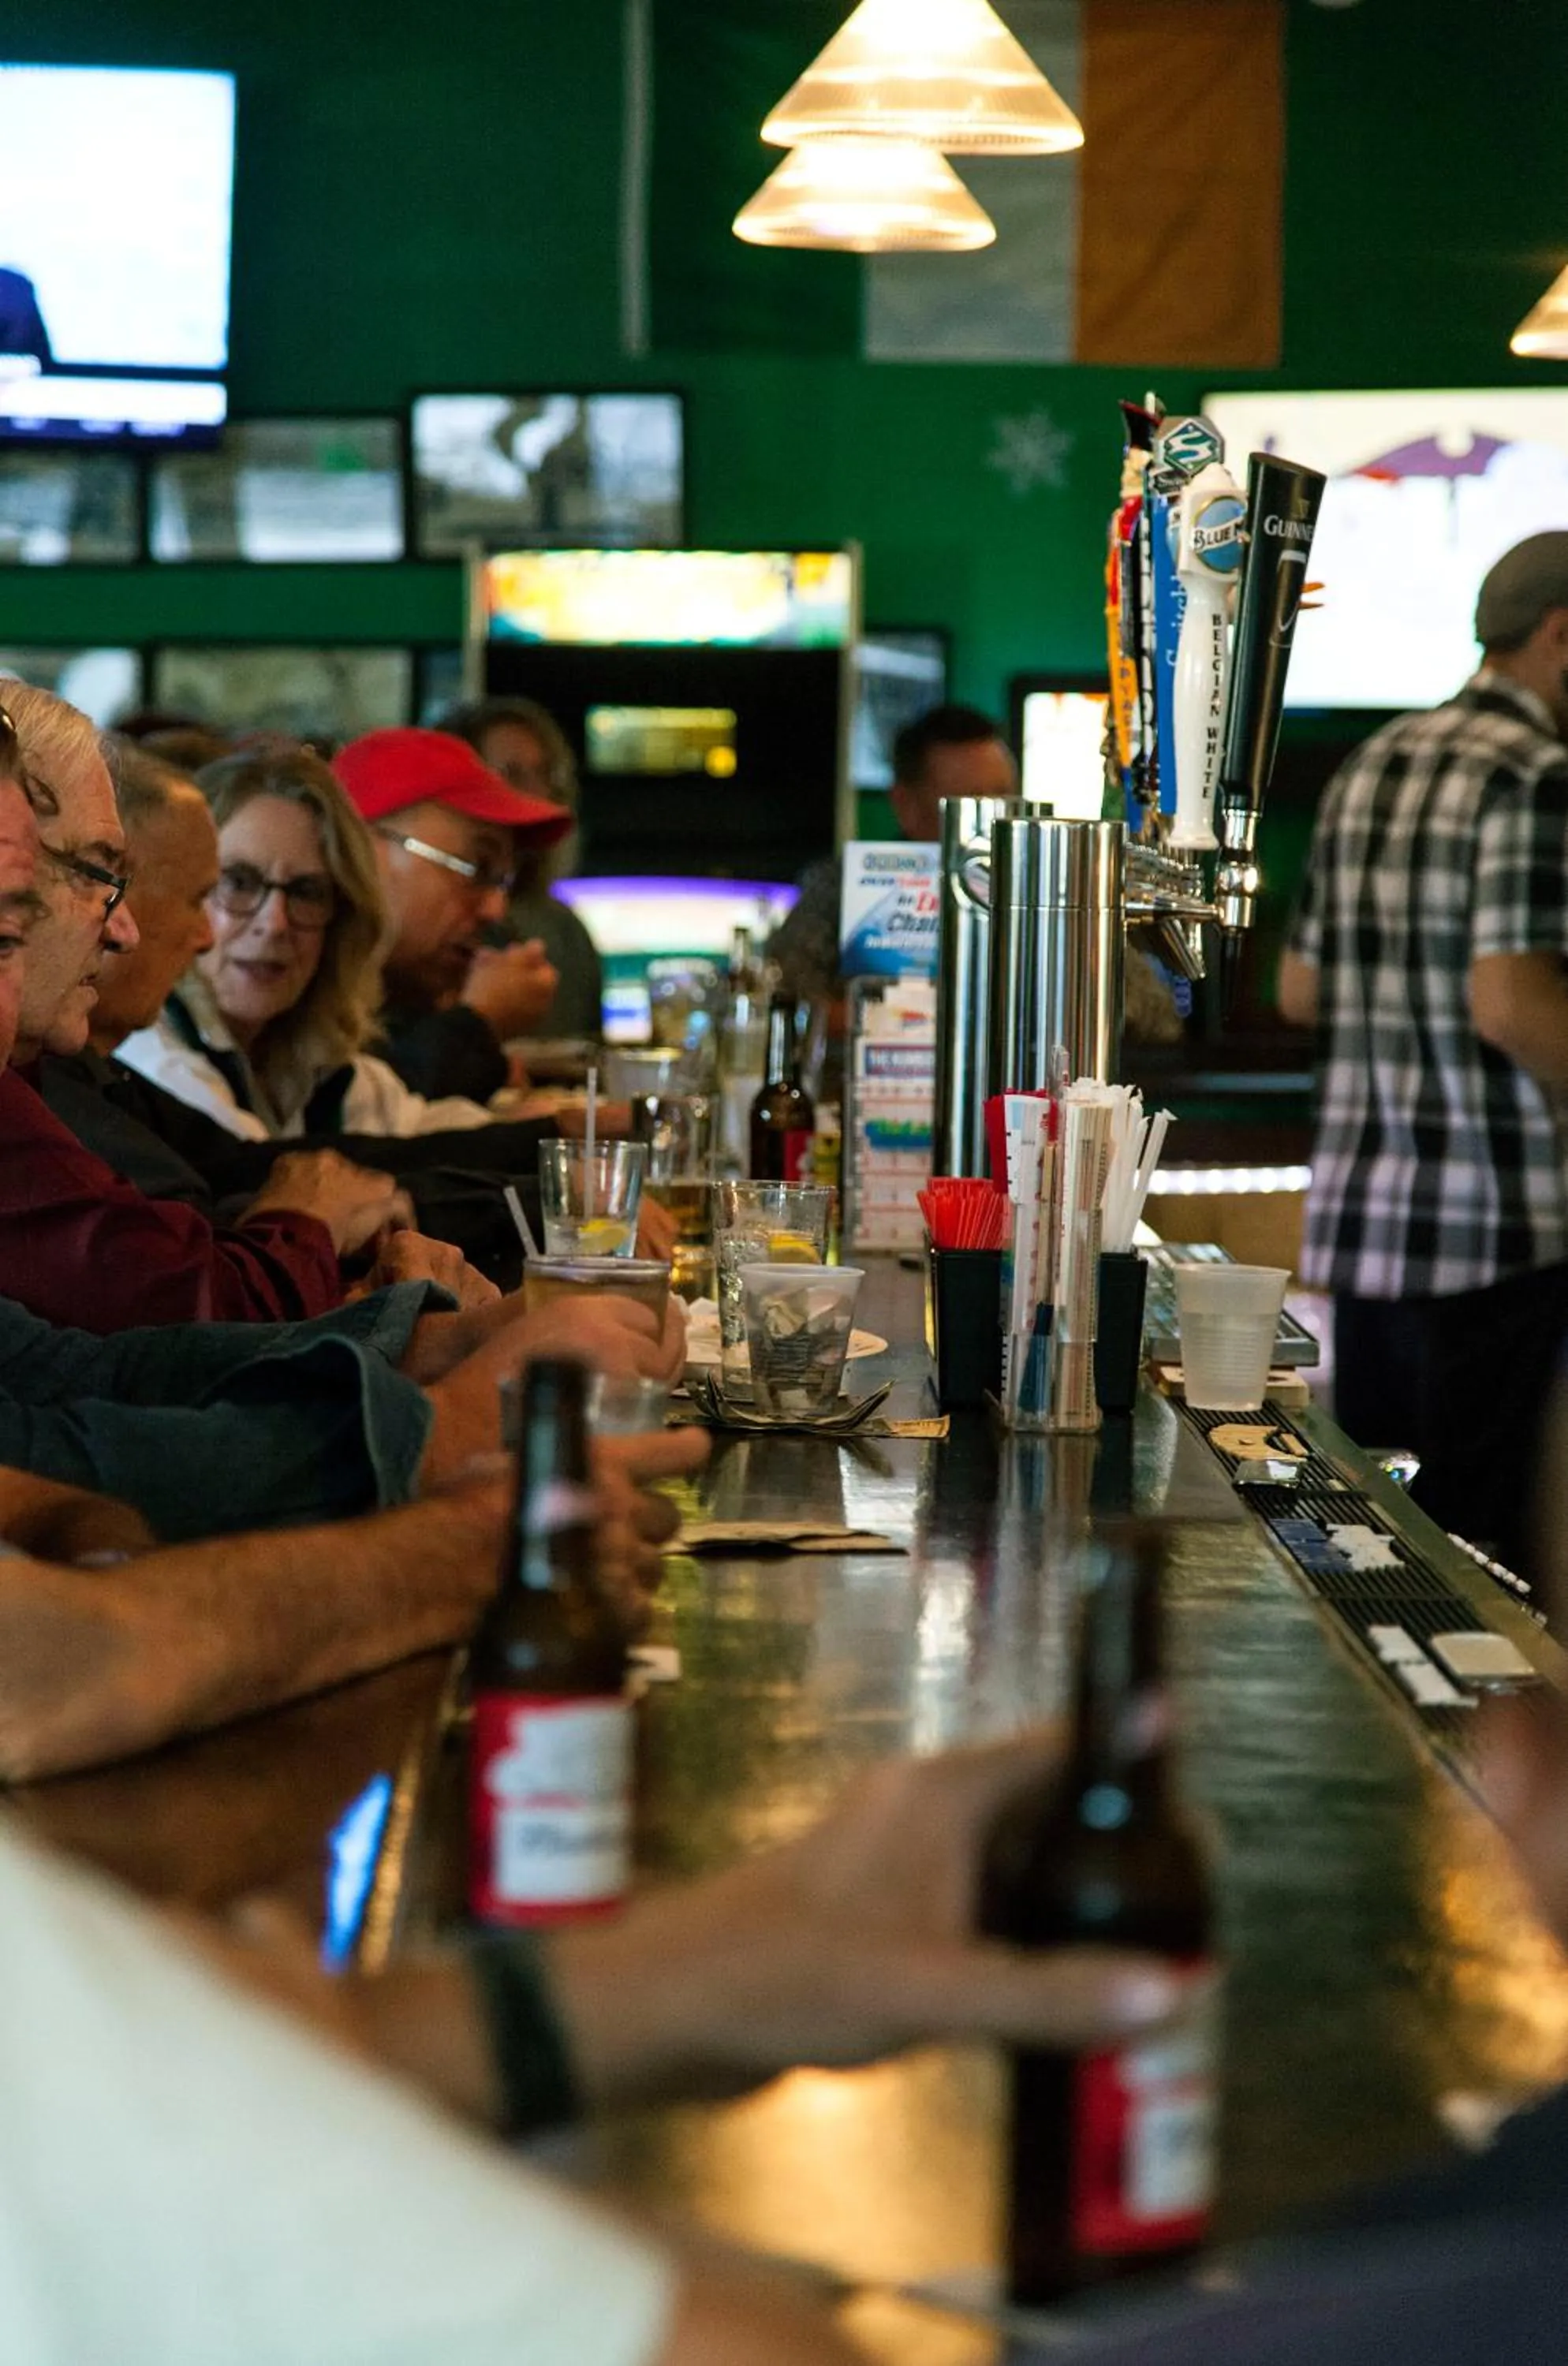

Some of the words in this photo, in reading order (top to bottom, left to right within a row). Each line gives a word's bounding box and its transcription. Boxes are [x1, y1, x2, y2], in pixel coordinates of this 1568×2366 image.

[1193, 524, 1231, 550] BLUE
[1264, 514, 1315, 543] GUINNE
[1210, 614, 1223, 718] BELGIAN
[1202, 726, 1219, 799] WHITE
